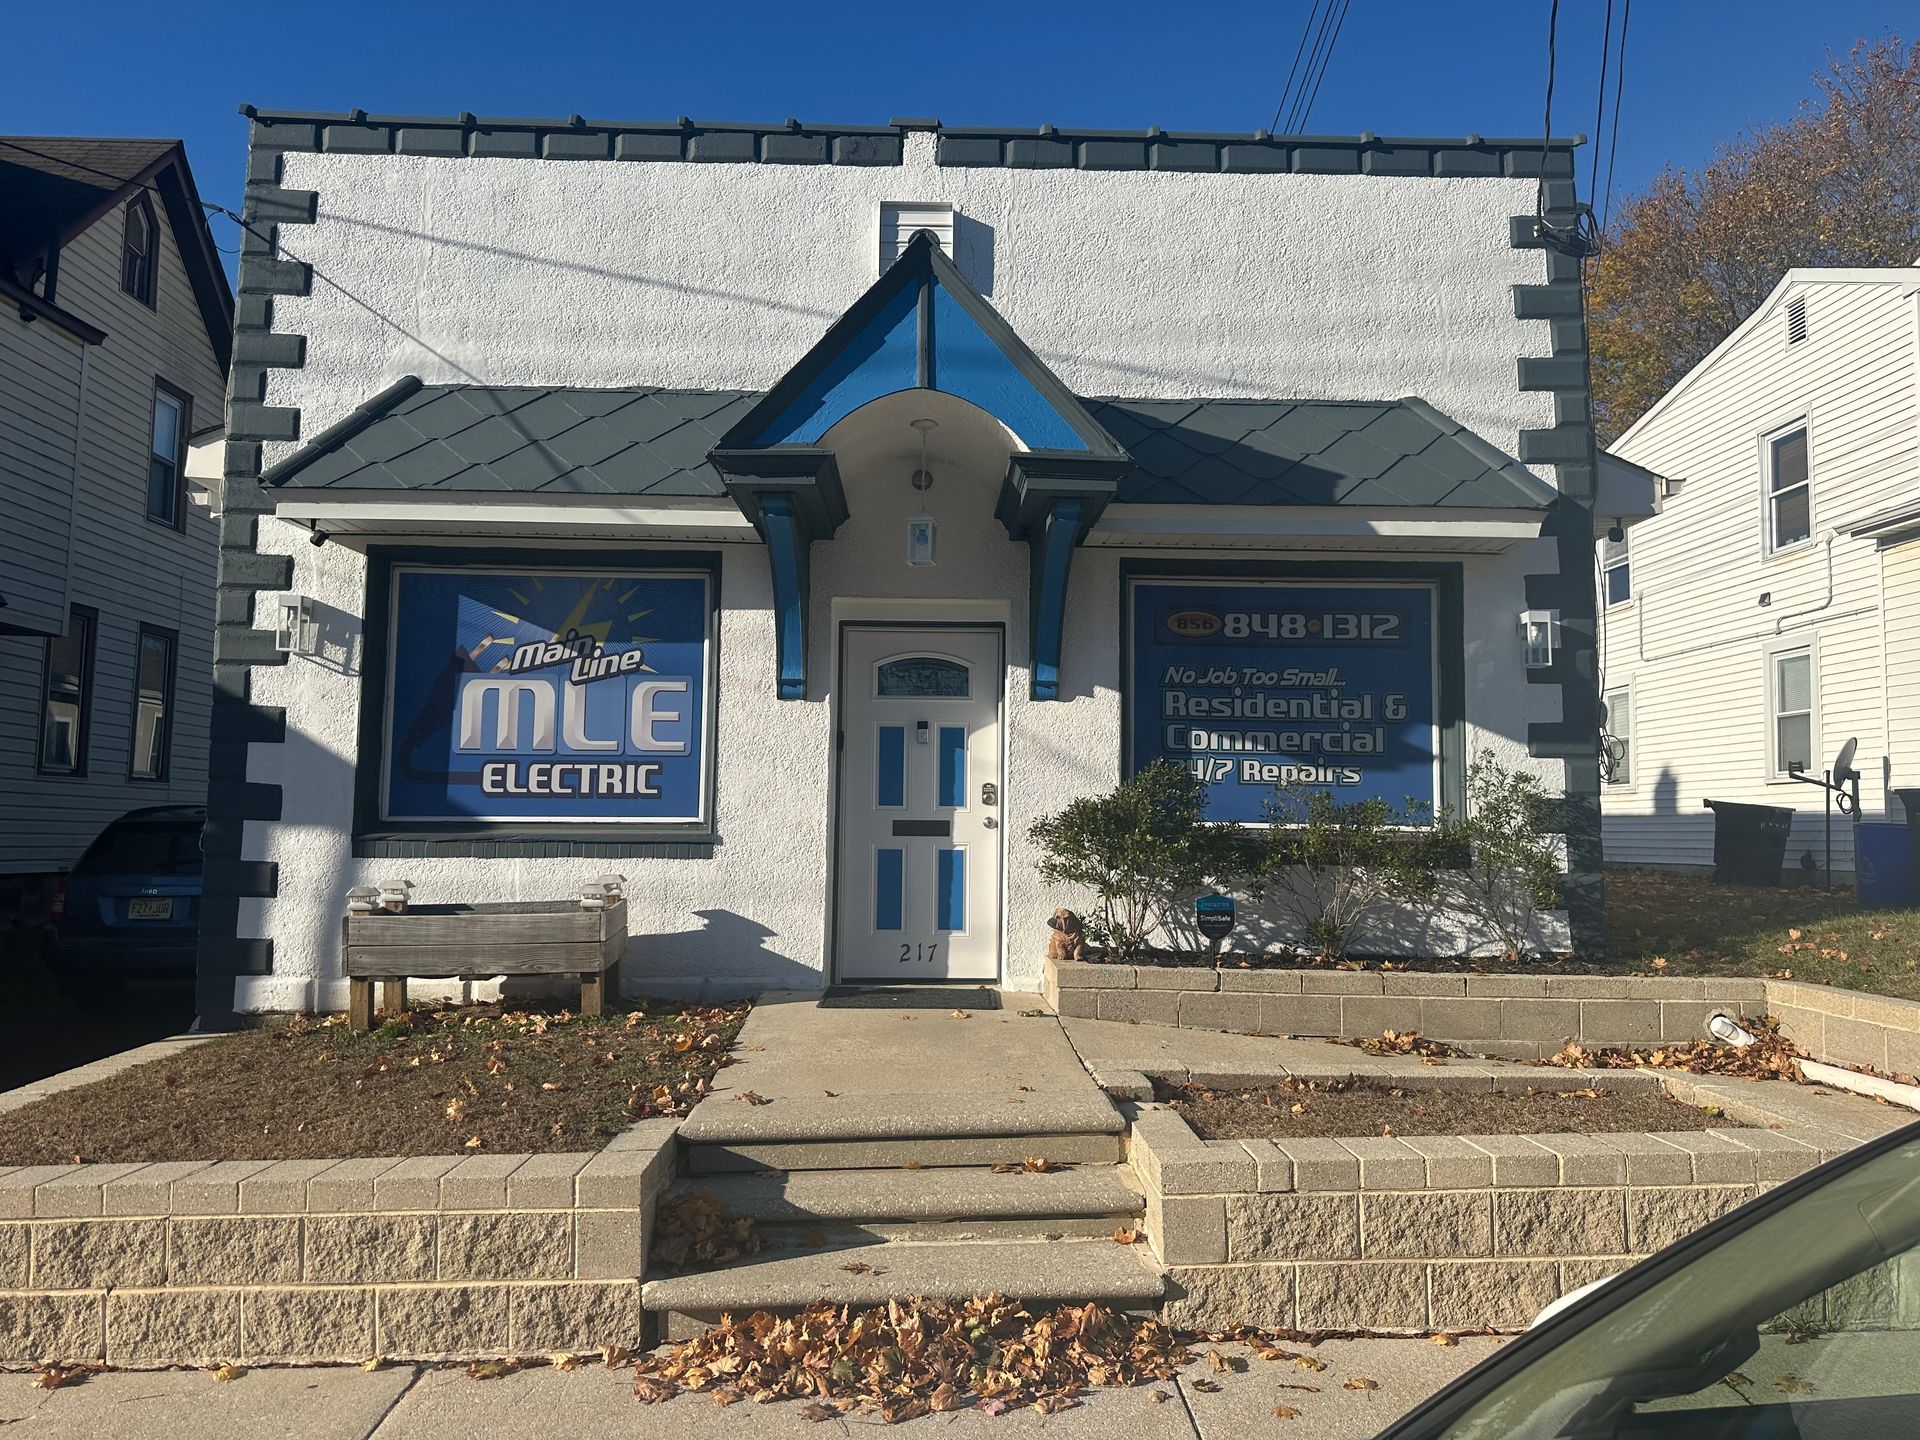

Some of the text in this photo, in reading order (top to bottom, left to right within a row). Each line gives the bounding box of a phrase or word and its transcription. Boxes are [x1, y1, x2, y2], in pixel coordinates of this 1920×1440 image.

[1176, 617, 1214, 631] 856
[513, 632, 594, 671] Main
[571, 647, 642, 683] Line
[1164, 666, 1195, 685] No
[1197, 666, 1236, 686] Job
[1242, 667, 1277, 686] Too
[458, 678, 688, 752] MLE
[1165, 687, 1408, 720] Residential &
[1165, 721, 1384, 754] Commercial
[482, 763, 660, 794] ELECTRIC
[1168, 756, 1361, 786] 4/7 Repairs
[899, 942, 938, 963] 217
